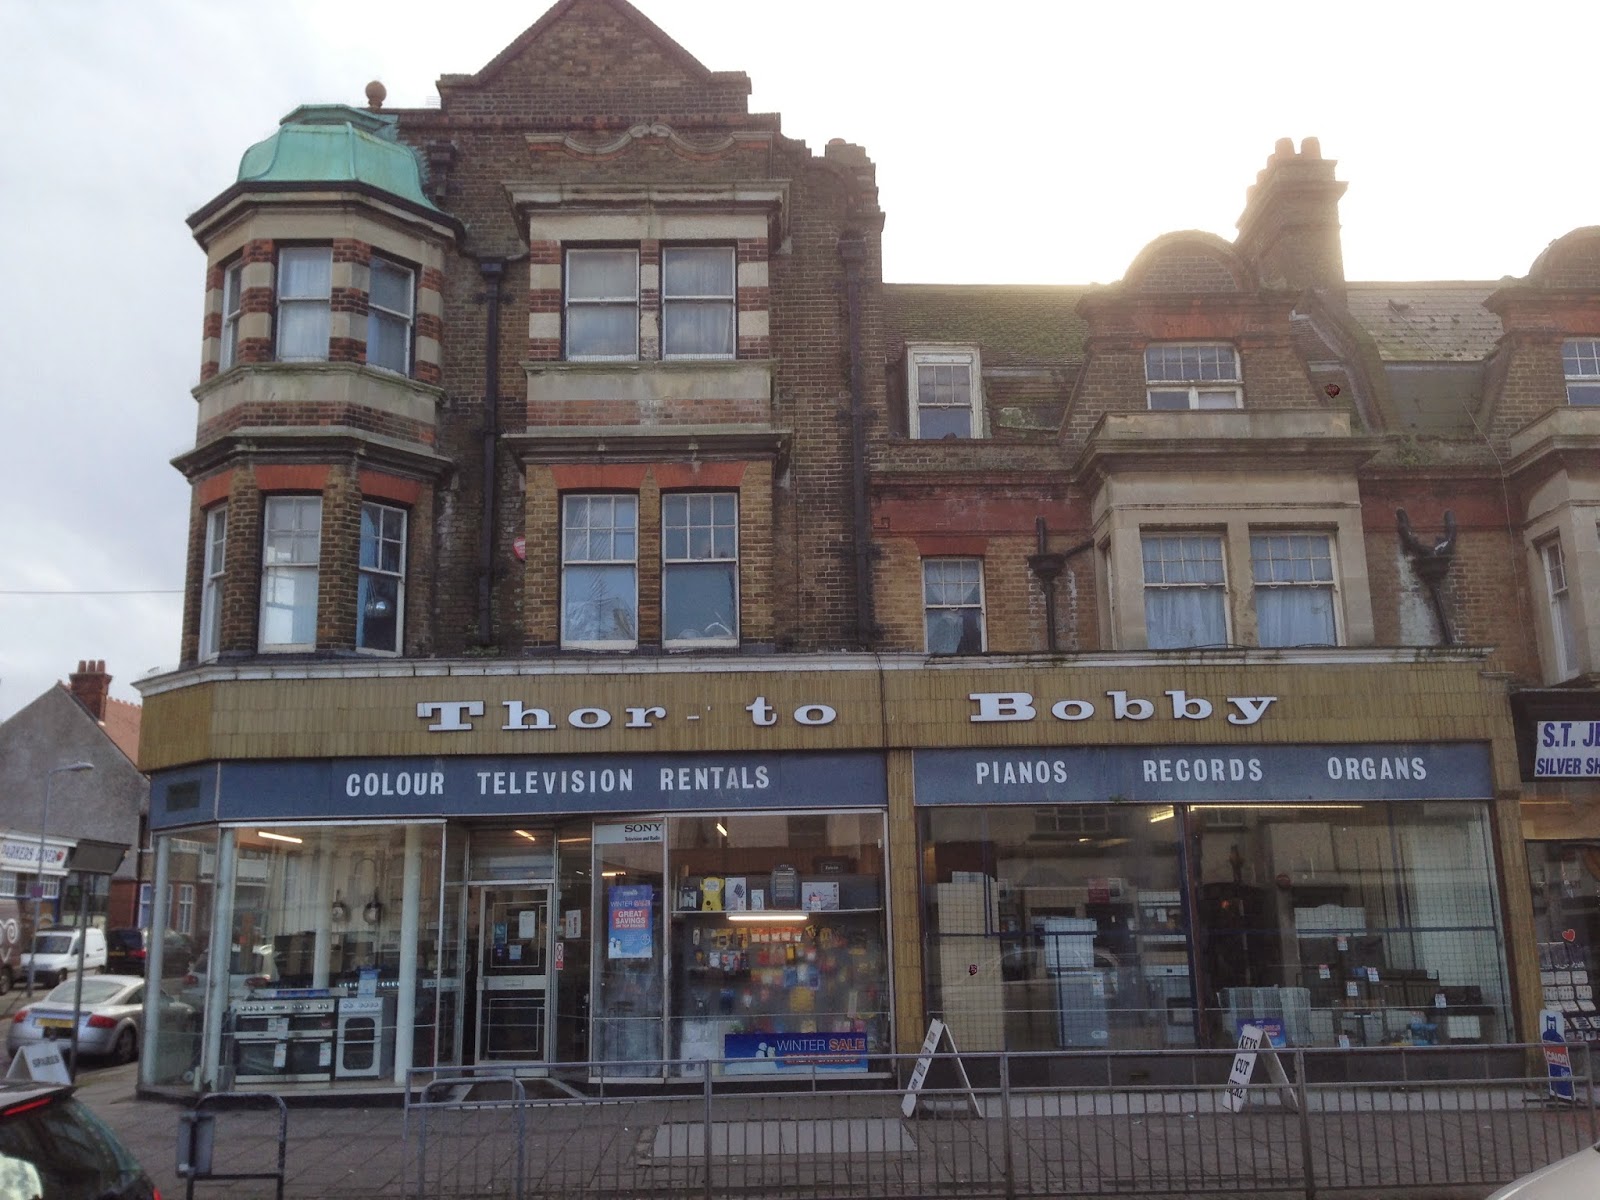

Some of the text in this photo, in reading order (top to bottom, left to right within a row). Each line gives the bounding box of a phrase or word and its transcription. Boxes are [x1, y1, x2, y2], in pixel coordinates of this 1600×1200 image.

[969, 689, 1278, 726] Bobby
[1542, 722, 1576, 748] S.T.
[975, 756, 1427, 785] PIANOS RECORDS ORGANS
[1536, 757, 1582, 775] SILVER
[345, 764, 770, 797] COLOUR TELEVISION RENTALS
[624, 823, 662, 833] SONY
[615, 917, 646, 925] SAVINGS
[618, 910, 643, 918] GREAT
[776, 1038, 866, 1052] WINTER SALE
[1239, 1035, 1258, 1051] KEYS
[1235, 1058, 1250, 1075] CUT
